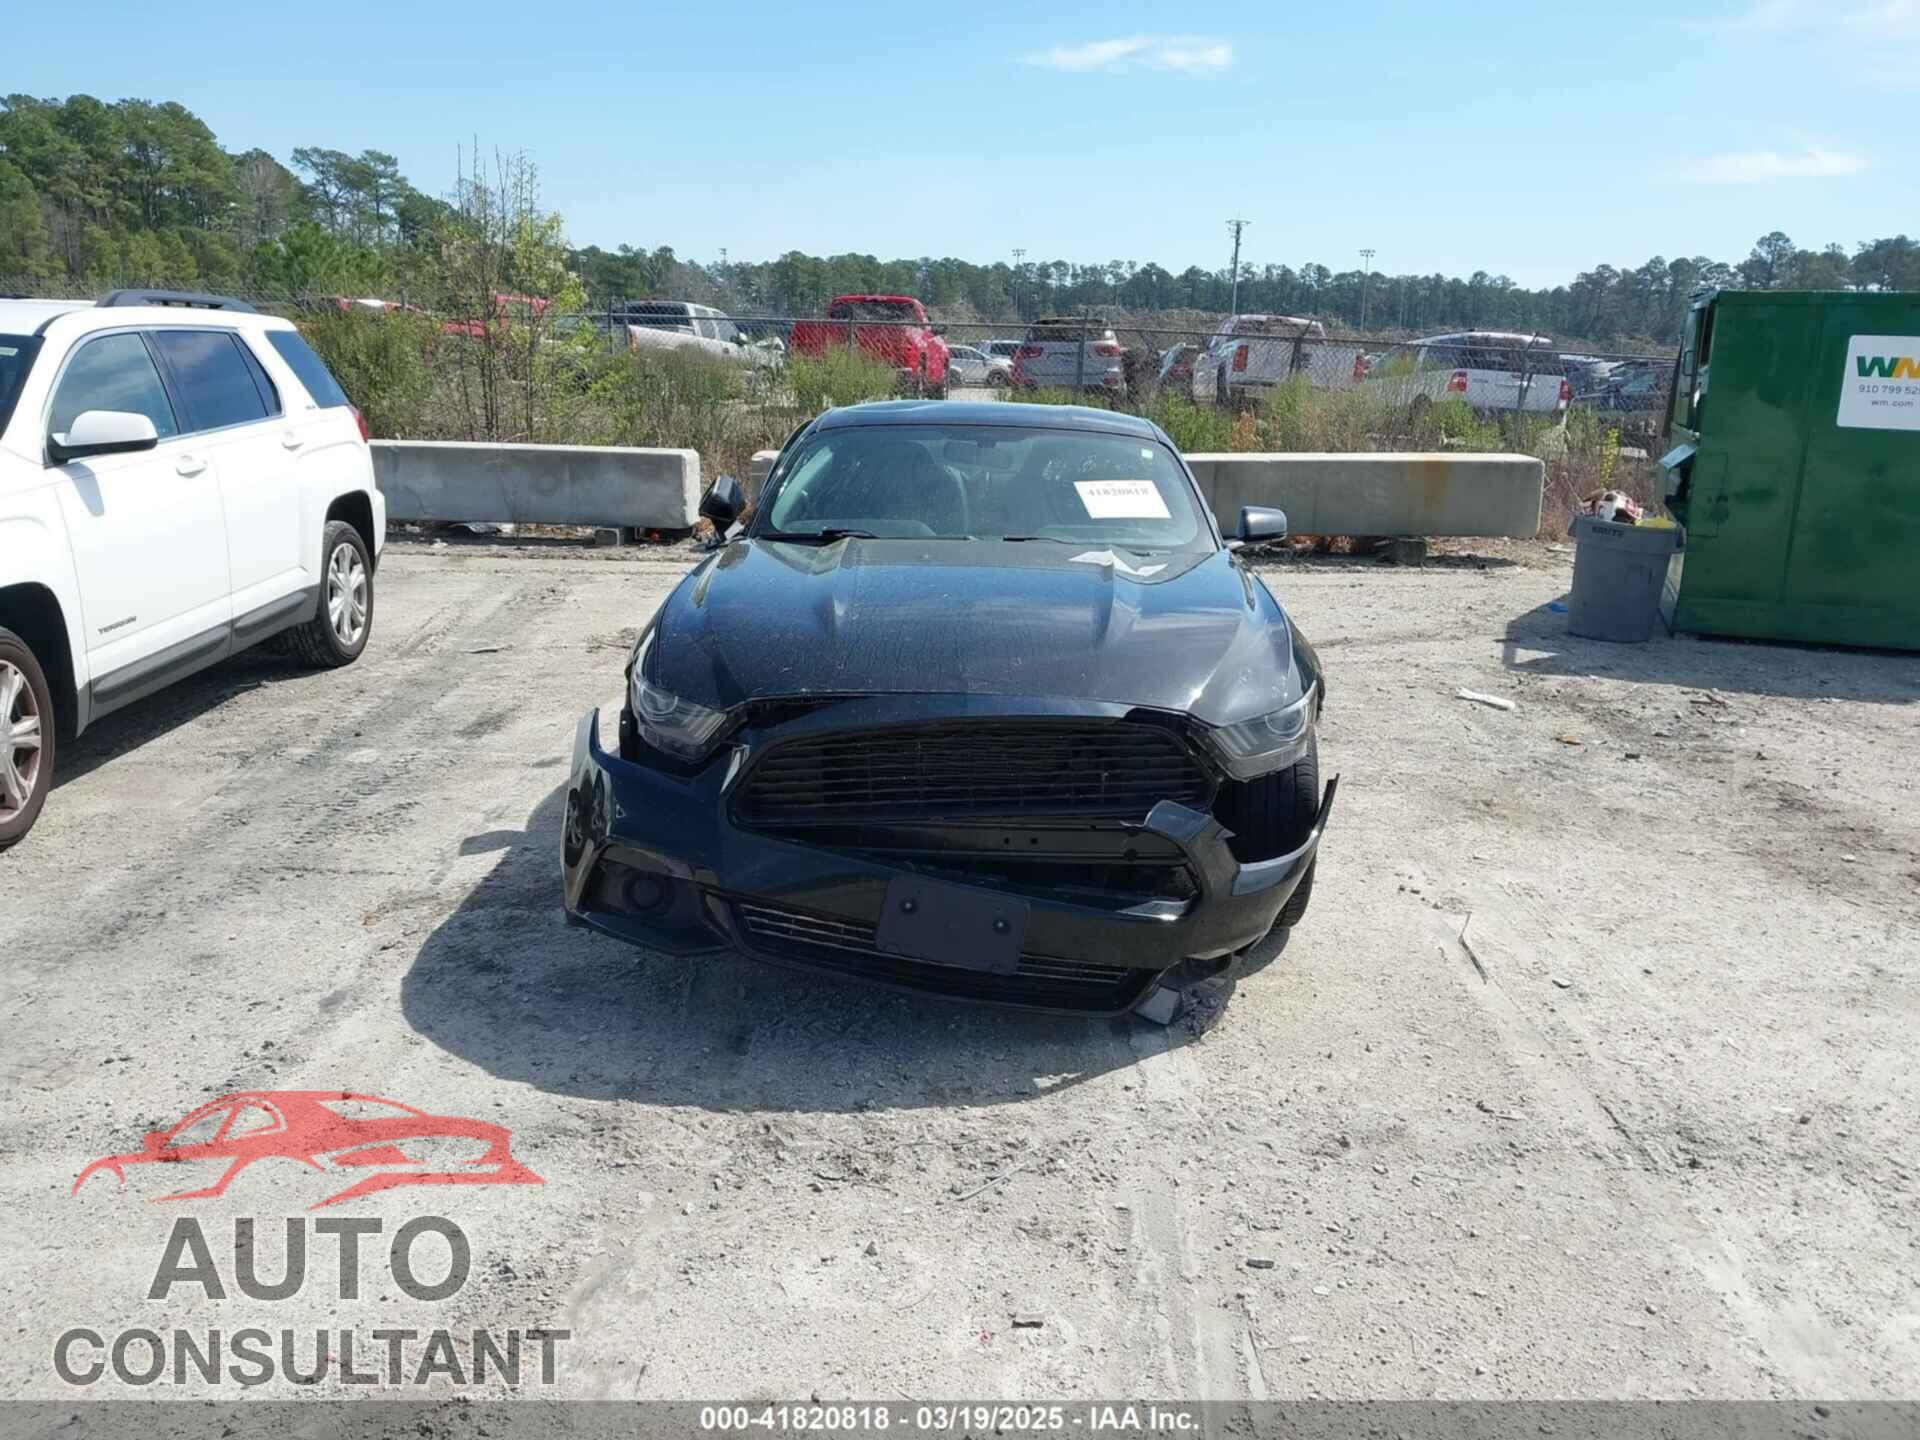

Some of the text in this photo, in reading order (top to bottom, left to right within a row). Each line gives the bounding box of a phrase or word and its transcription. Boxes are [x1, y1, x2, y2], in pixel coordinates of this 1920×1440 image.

[1858, 384, 1879, 394] 910
[1880, 384, 1902, 394] 799
[1871, 400, 1914, 409] wm.com
